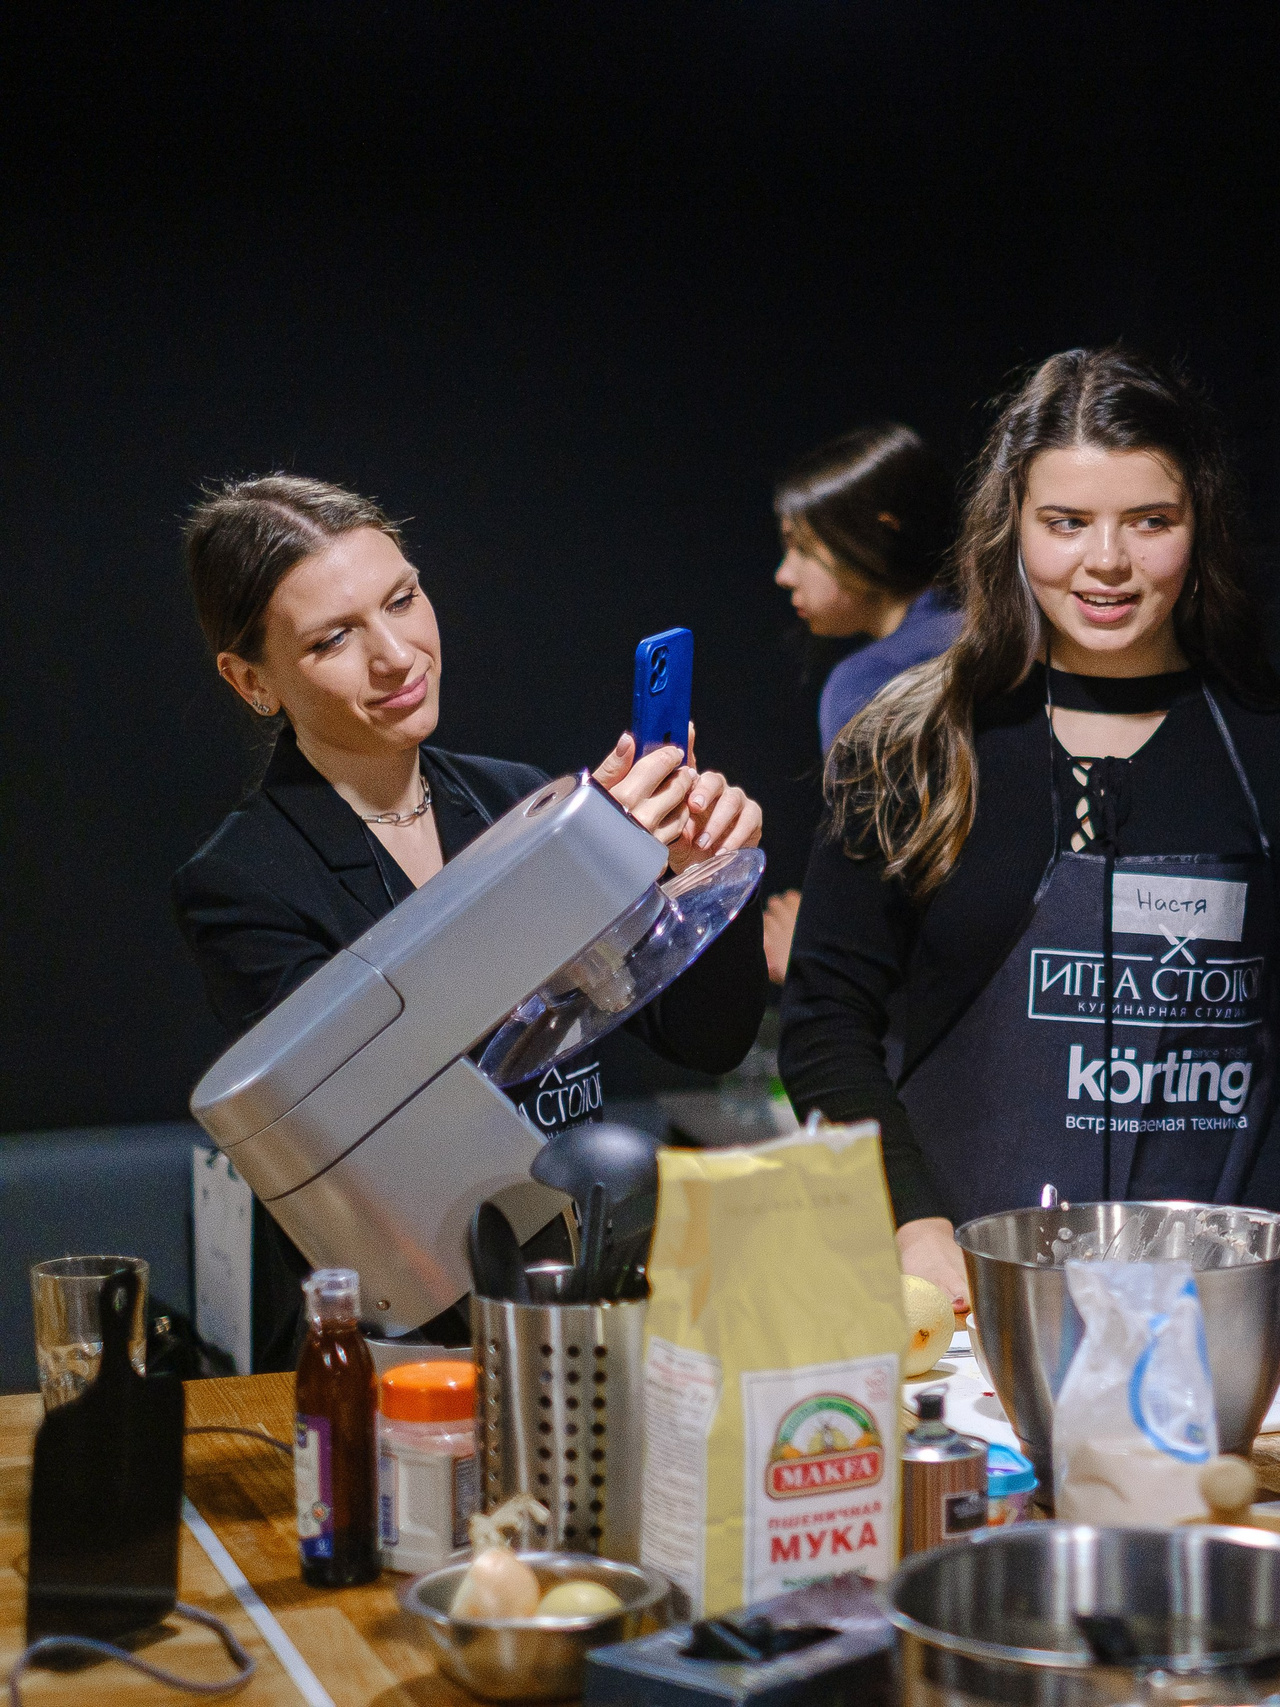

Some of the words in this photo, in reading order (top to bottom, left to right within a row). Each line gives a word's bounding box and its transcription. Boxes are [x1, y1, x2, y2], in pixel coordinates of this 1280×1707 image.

[1137, 888, 1207, 915] Настя
[1152, 966, 1259, 1003] СТОЛО
[1067, 1045, 1252, 1115] körting
[1065, 1115, 1185, 1134] встраиваемая
[1190, 1115, 1248, 1131] техника
[770, 1521, 878, 1563] МУКА
